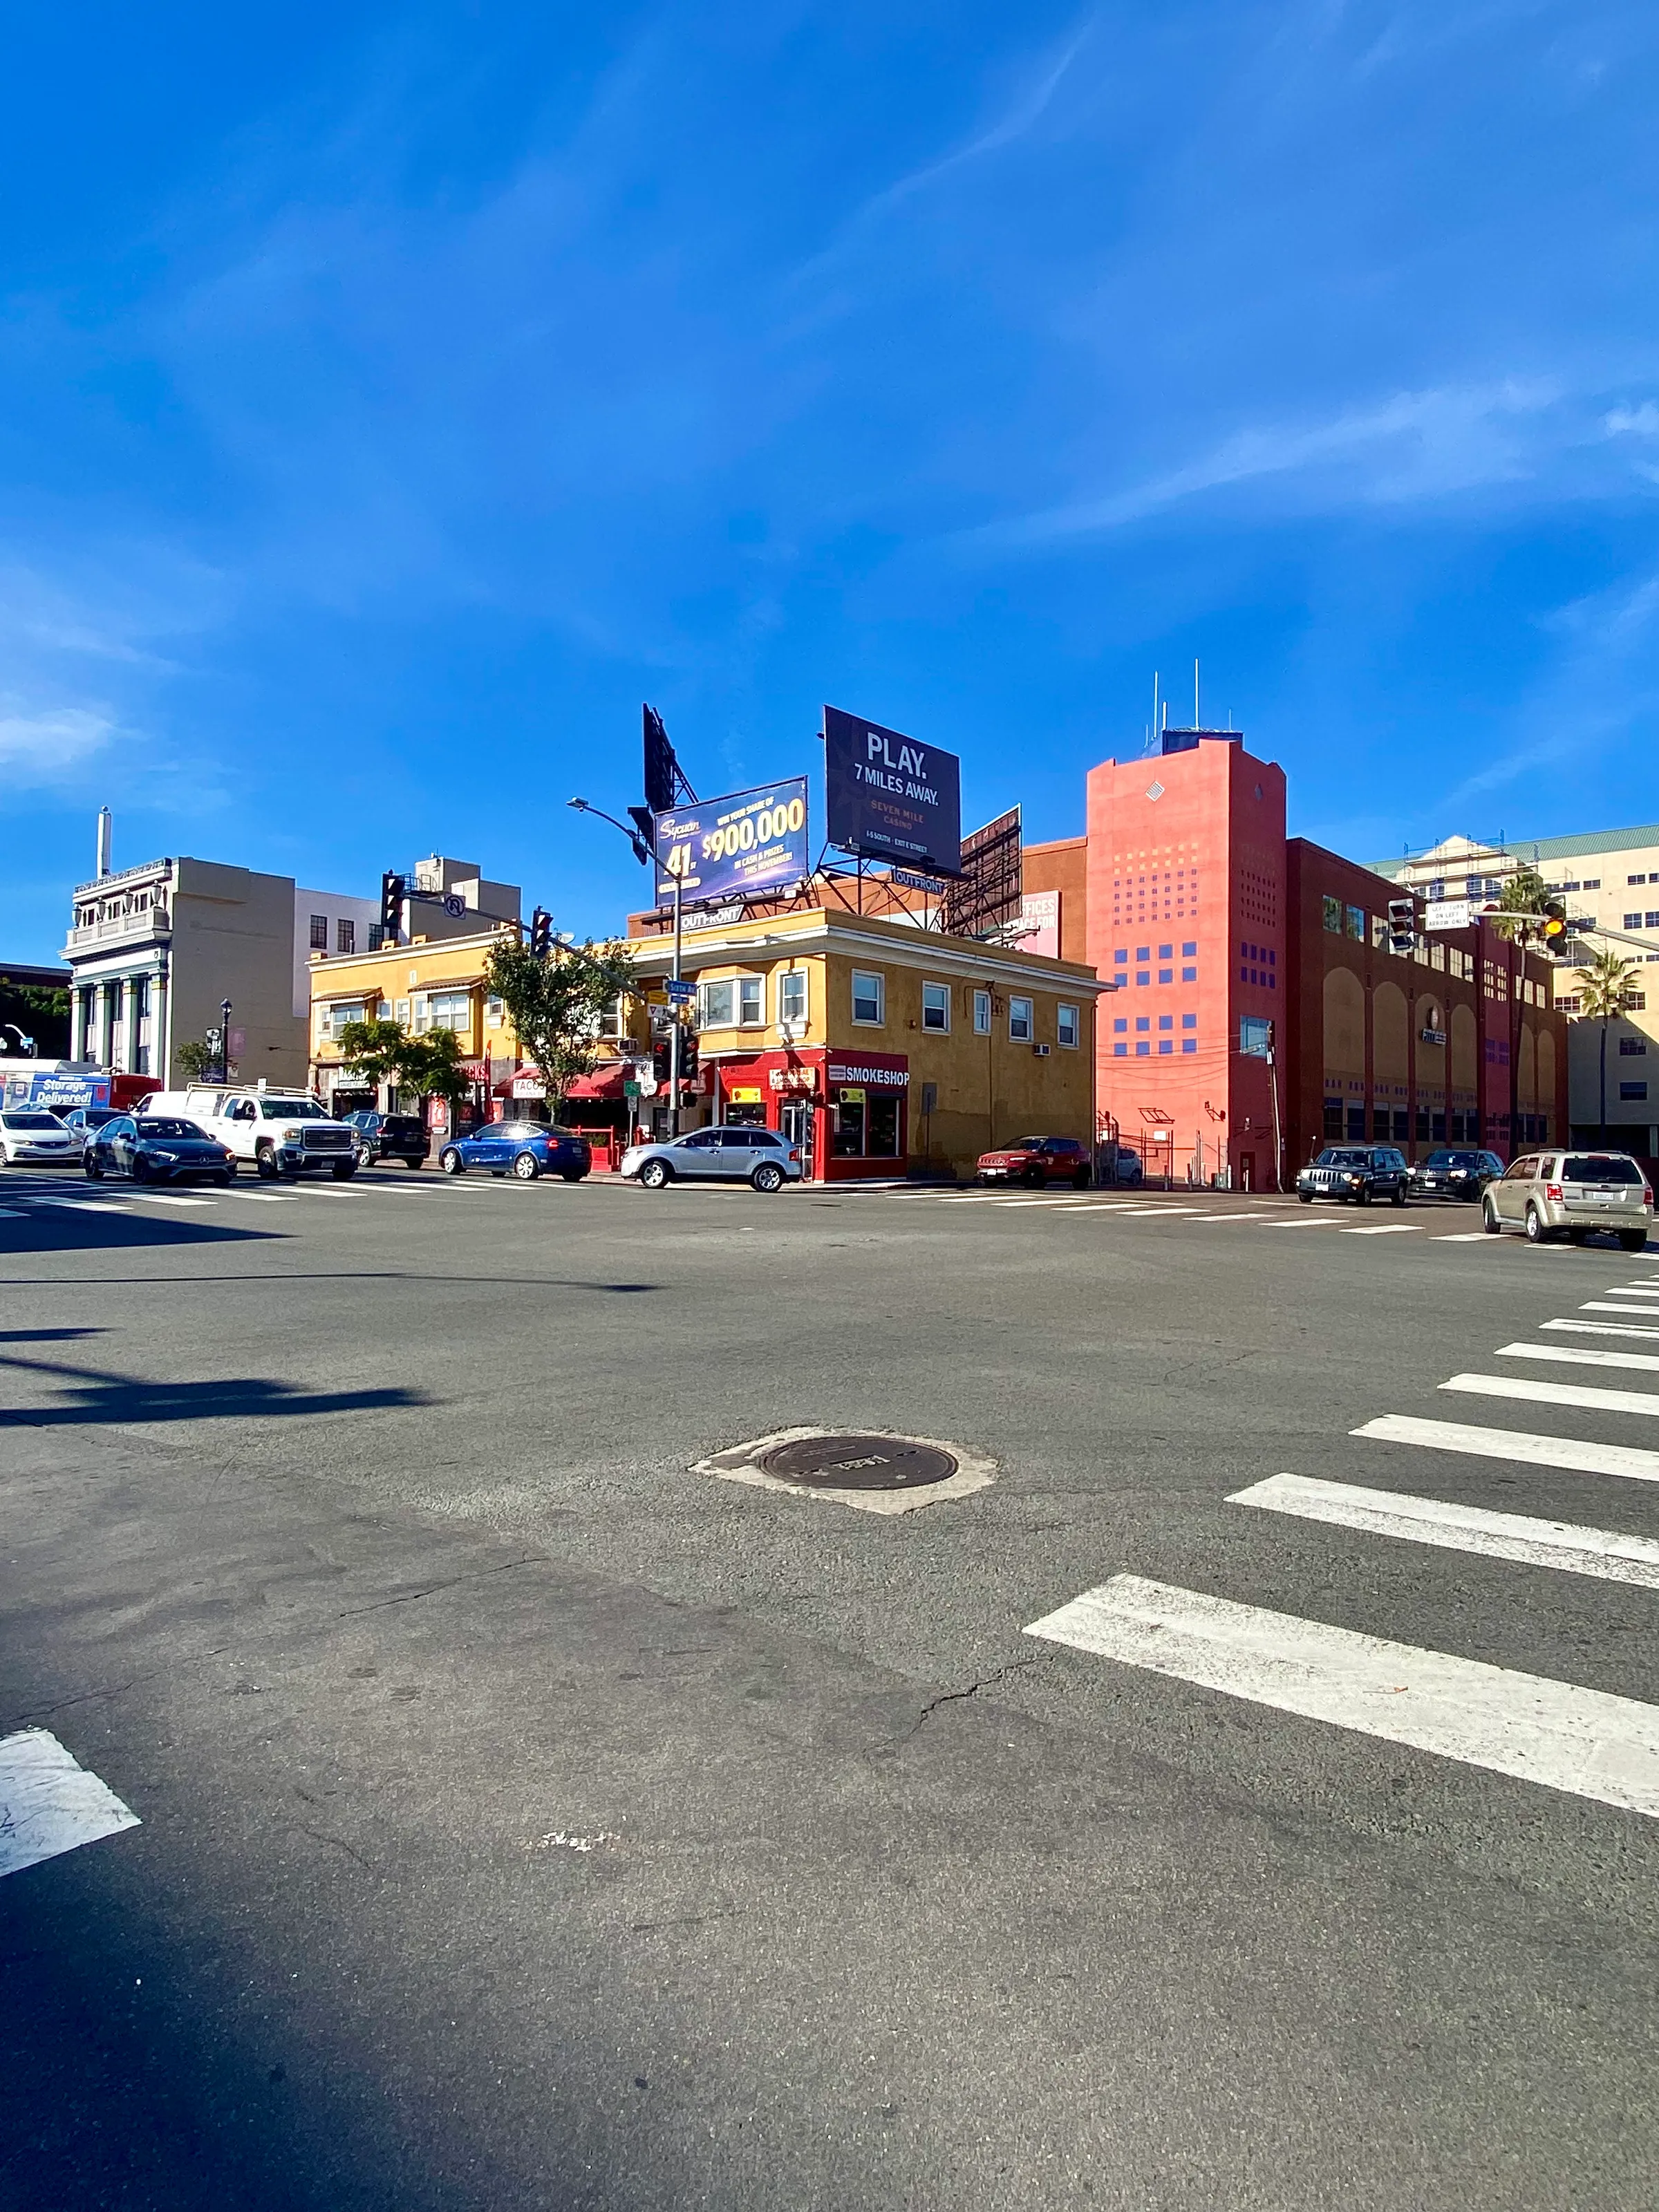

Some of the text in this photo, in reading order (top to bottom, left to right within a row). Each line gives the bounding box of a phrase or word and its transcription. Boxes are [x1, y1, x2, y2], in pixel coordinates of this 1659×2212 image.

[867, 731, 927, 780] PLAY.
[854, 762, 939, 806] 7 MILES AWAY.
[871, 799, 924, 824] SEVEN MILE
[659, 818, 700, 841] Sycuan
[702, 798, 805, 863] $900,000
[883, 815, 912, 831] CASINO
[896, 871, 944, 893] OUTFRONT
[1036, 915, 1056, 930] FOR
[43, 1079, 86, 1093] Storage
[846, 1067, 910, 1086] SMOKESHOP
[37, 1091, 93, 1105] Delivered!
